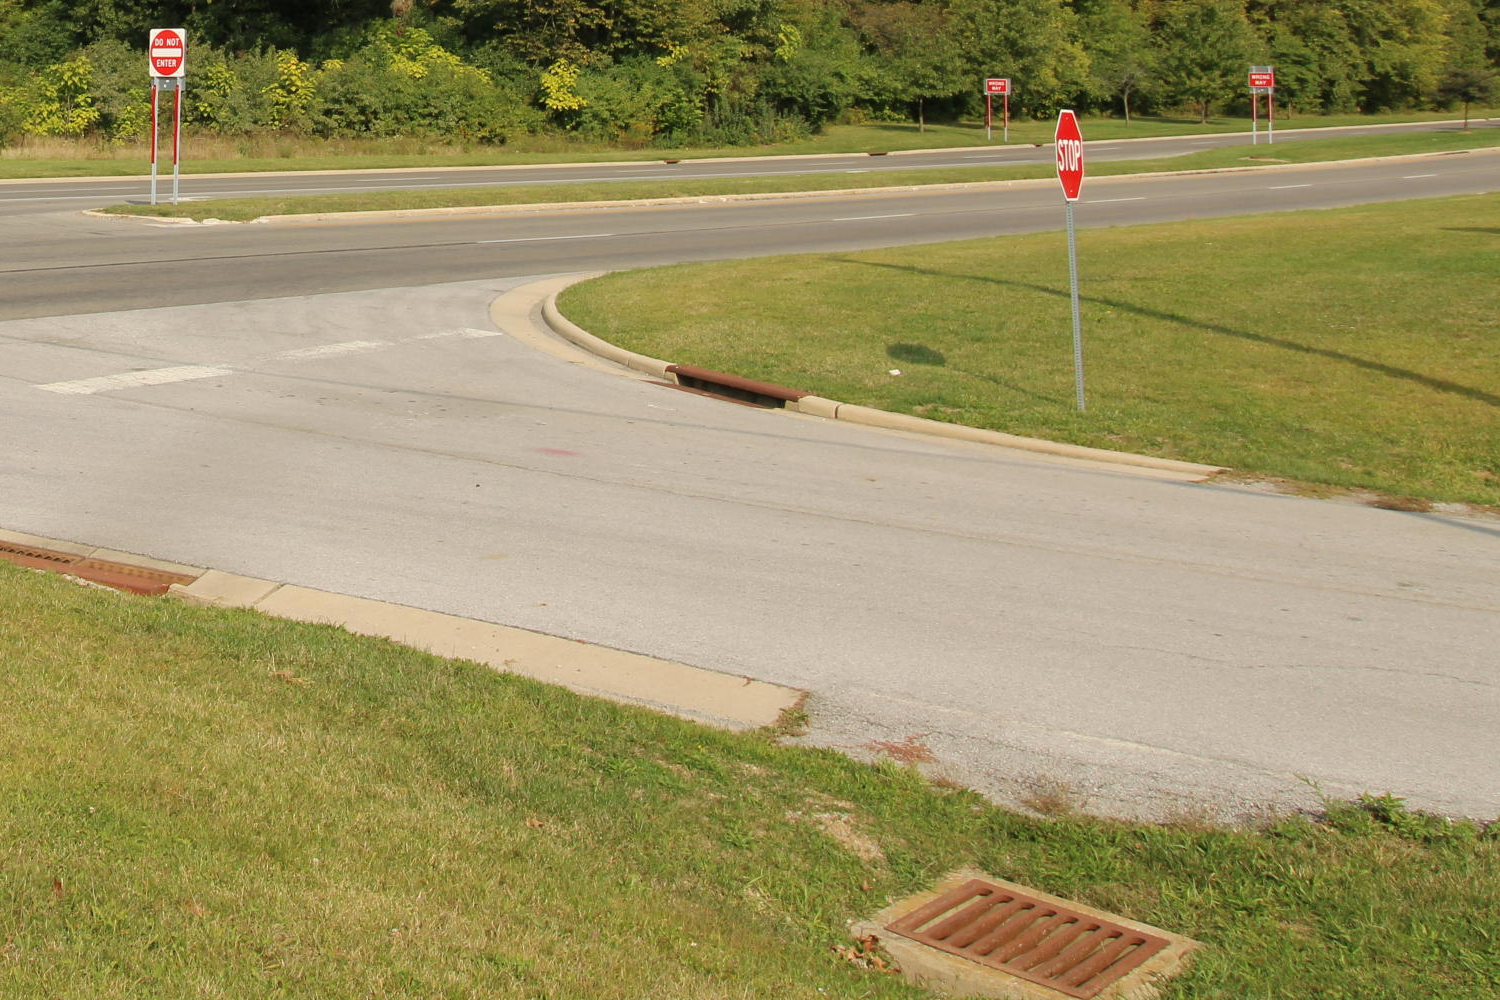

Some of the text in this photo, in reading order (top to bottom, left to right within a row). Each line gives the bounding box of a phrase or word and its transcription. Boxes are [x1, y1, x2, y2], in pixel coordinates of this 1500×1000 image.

[154, 38, 180, 46] DO NOT
[156, 59, 177, 67] ENTER
[1057, 139, 1081, 172] STOP
